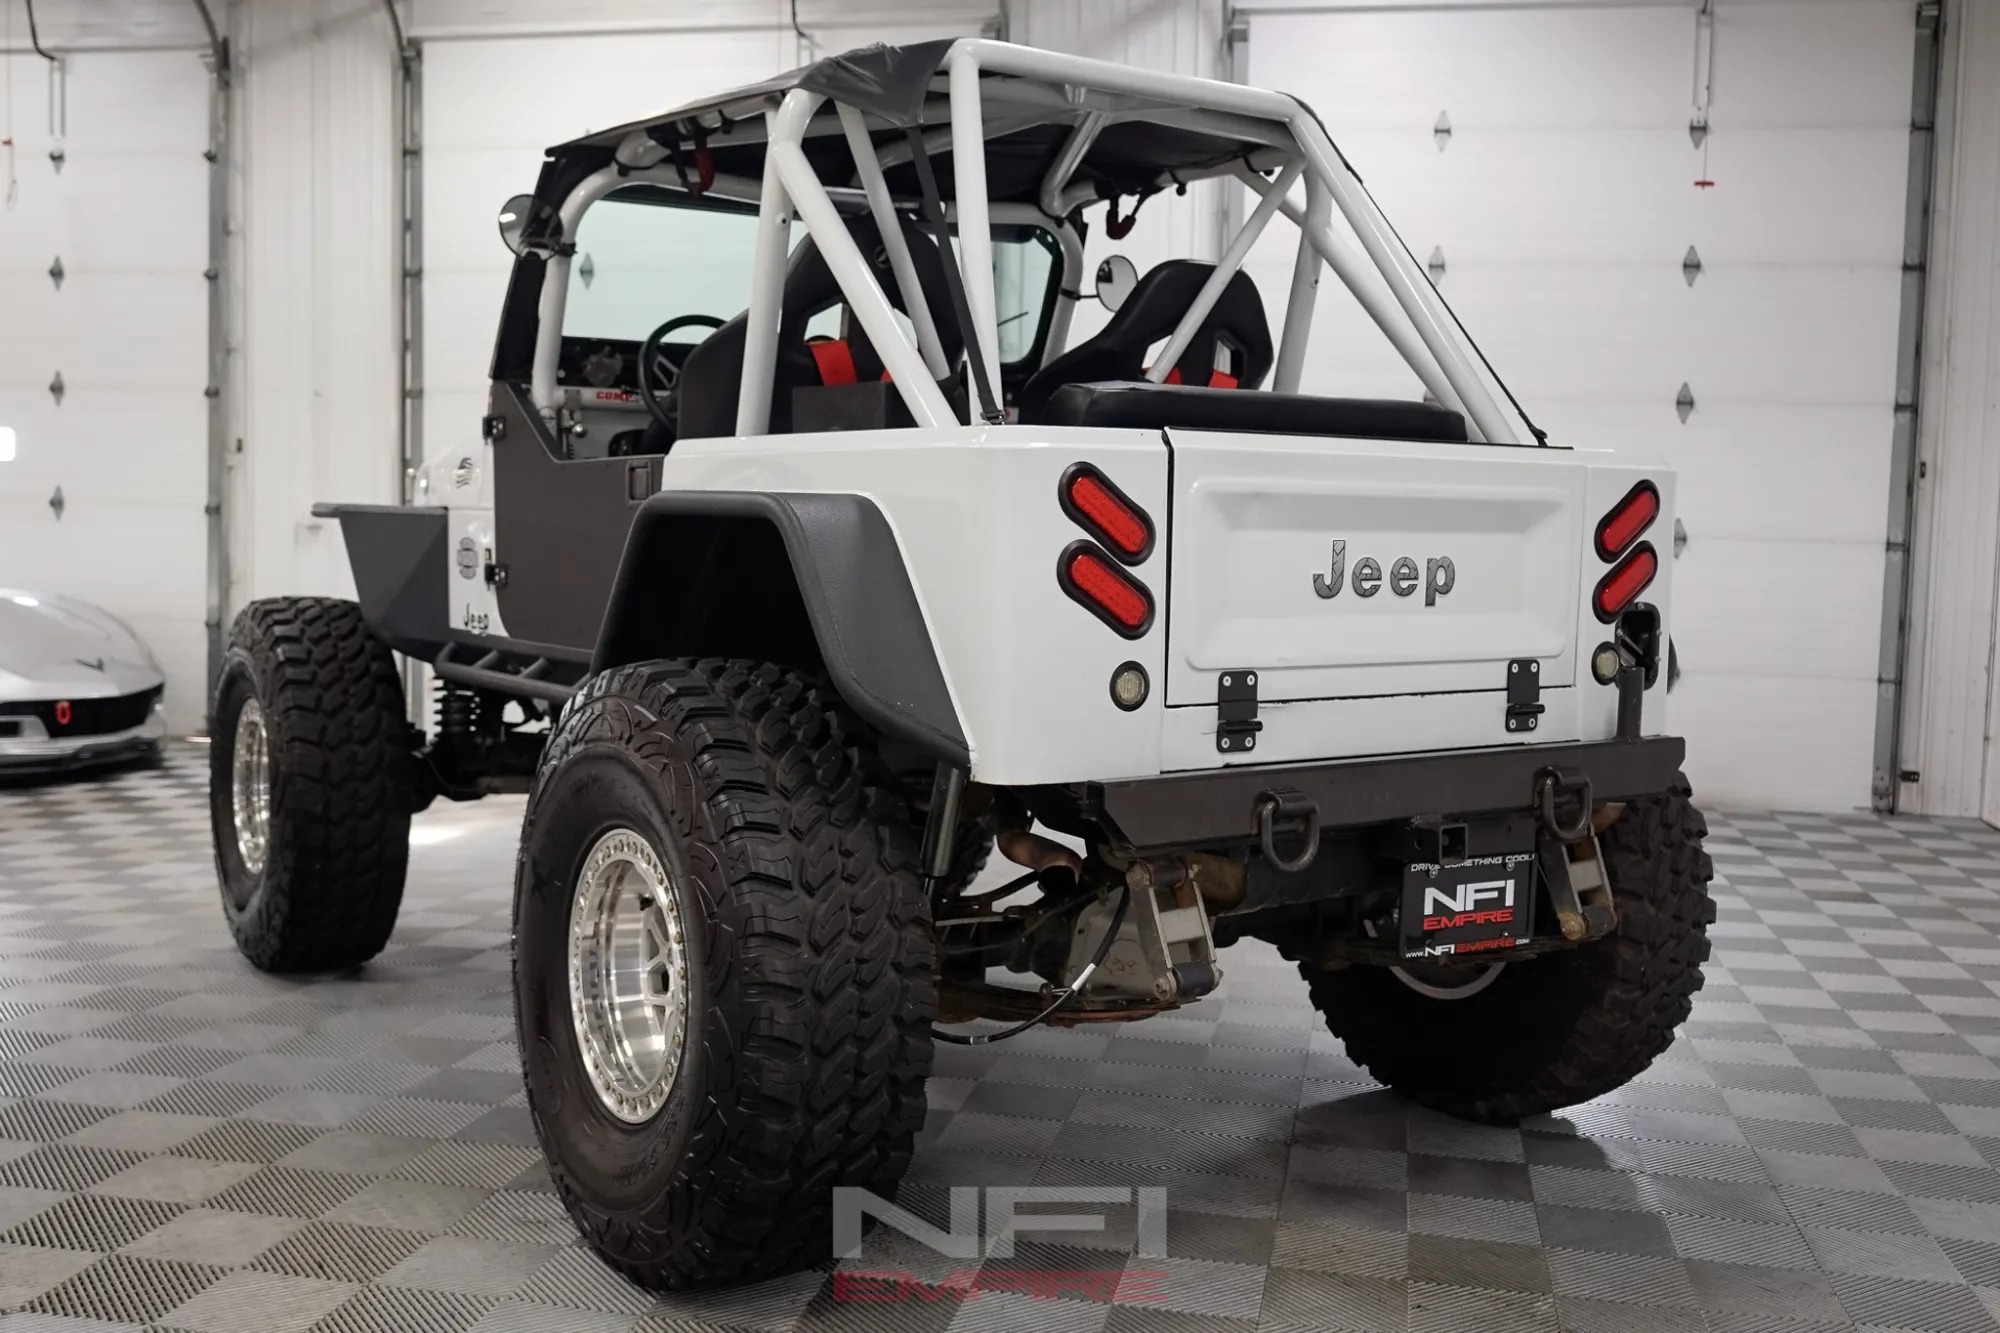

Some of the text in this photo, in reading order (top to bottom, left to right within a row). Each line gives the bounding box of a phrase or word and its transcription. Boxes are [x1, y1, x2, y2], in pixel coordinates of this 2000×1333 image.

[1312, 539, 1456, 608] Jeep
[464, 603, 489, 632] Jeep
[1424, 879, 1515, 916] NFI
[1423, 908, 1514, 931] EMPIRE
